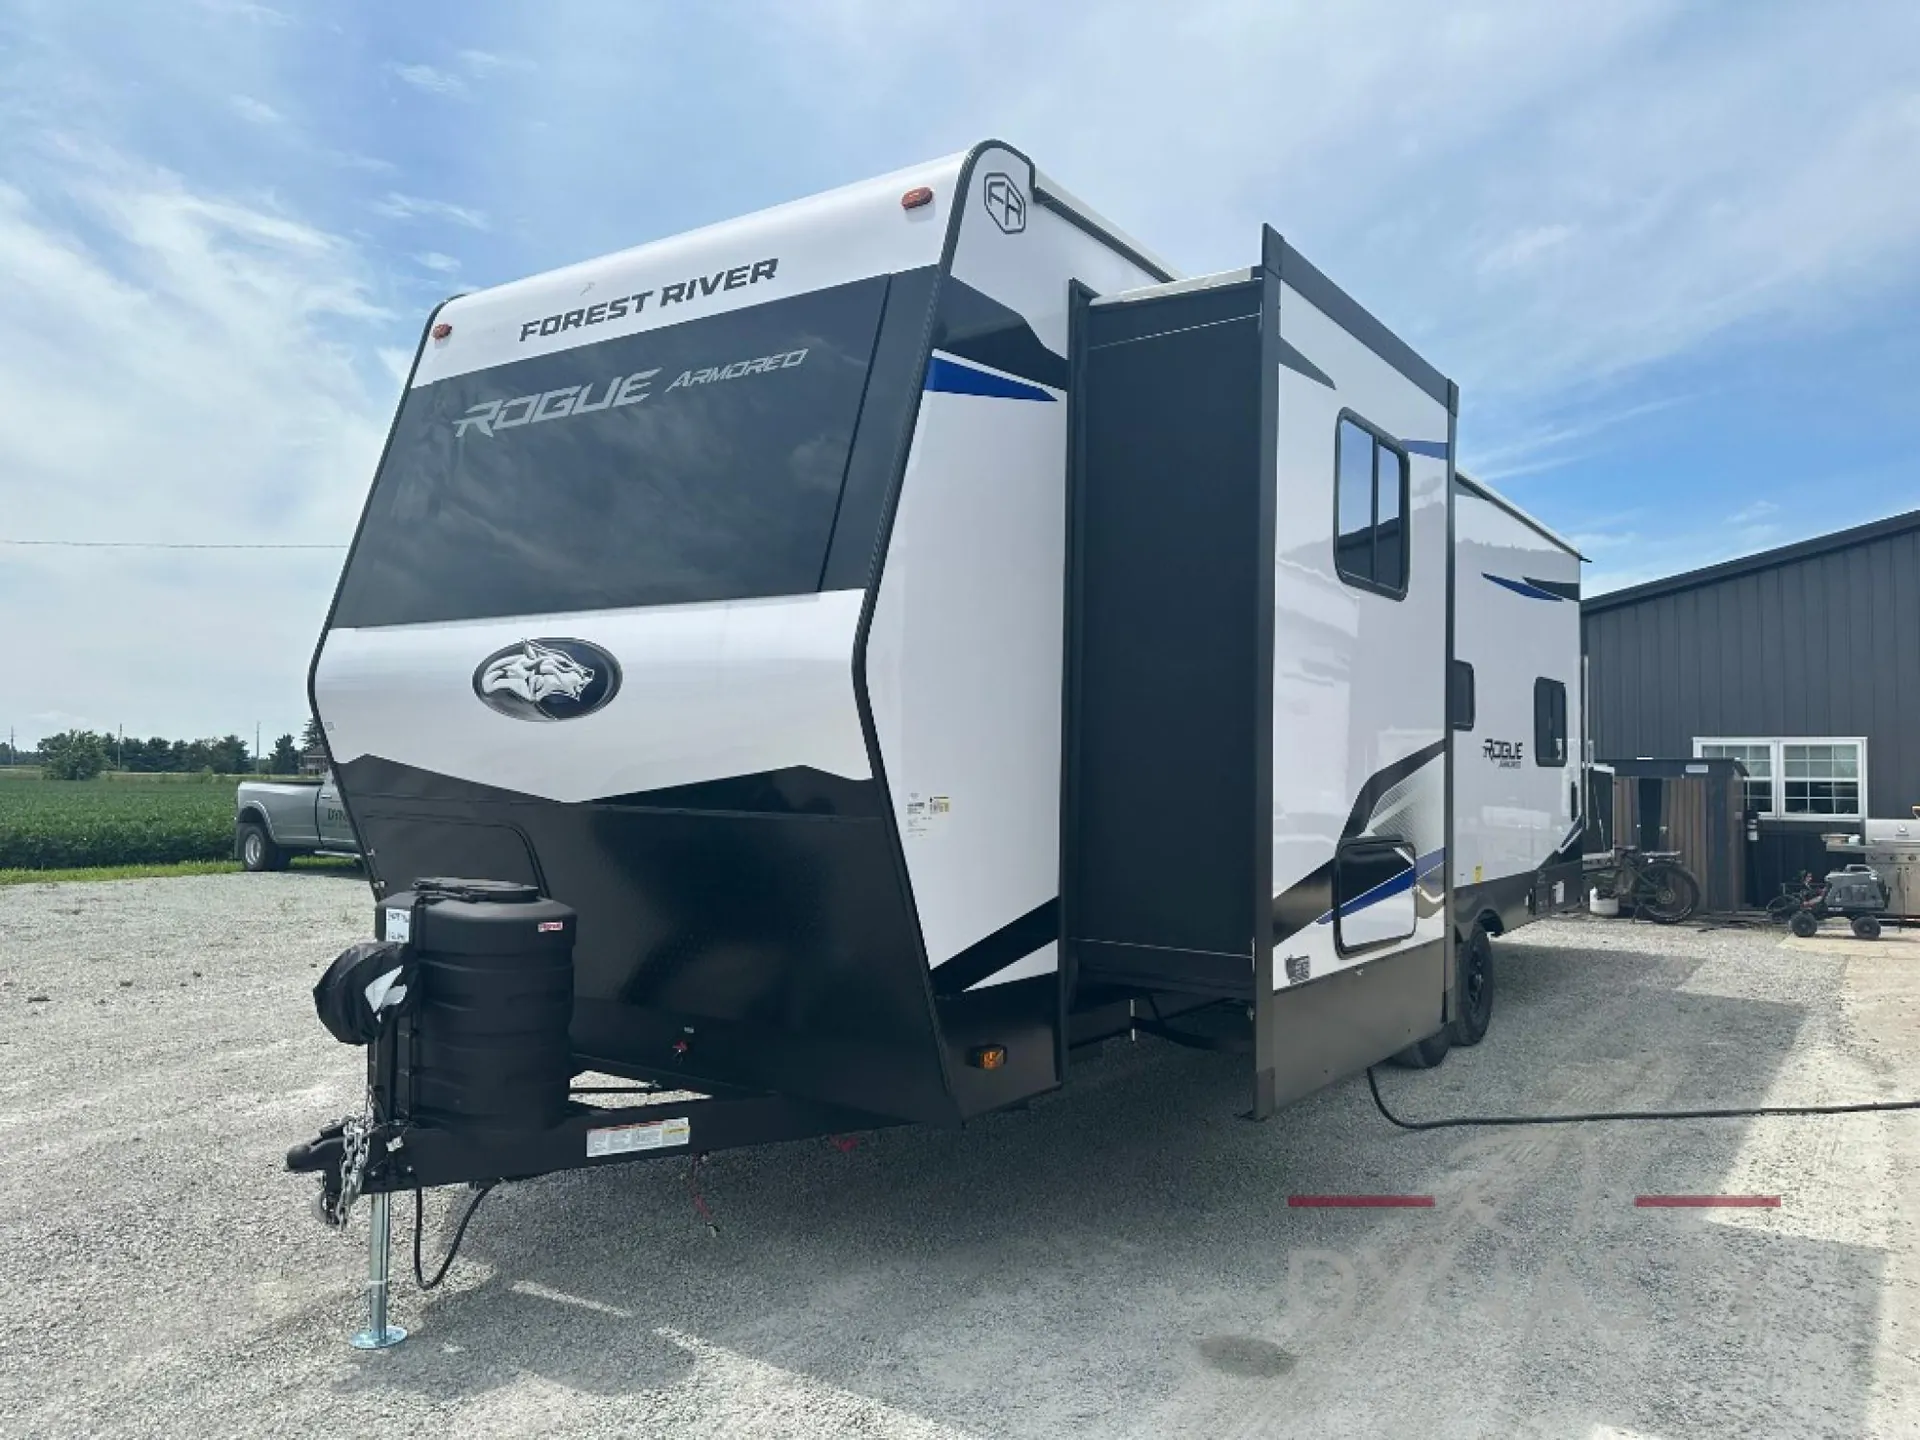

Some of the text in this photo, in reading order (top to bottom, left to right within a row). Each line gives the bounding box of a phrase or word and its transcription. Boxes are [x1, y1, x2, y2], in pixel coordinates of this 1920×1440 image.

[519, 257, 779, 342] FOREST RIVER
[452, 348, 811, 438] ROGUE ARMORED
